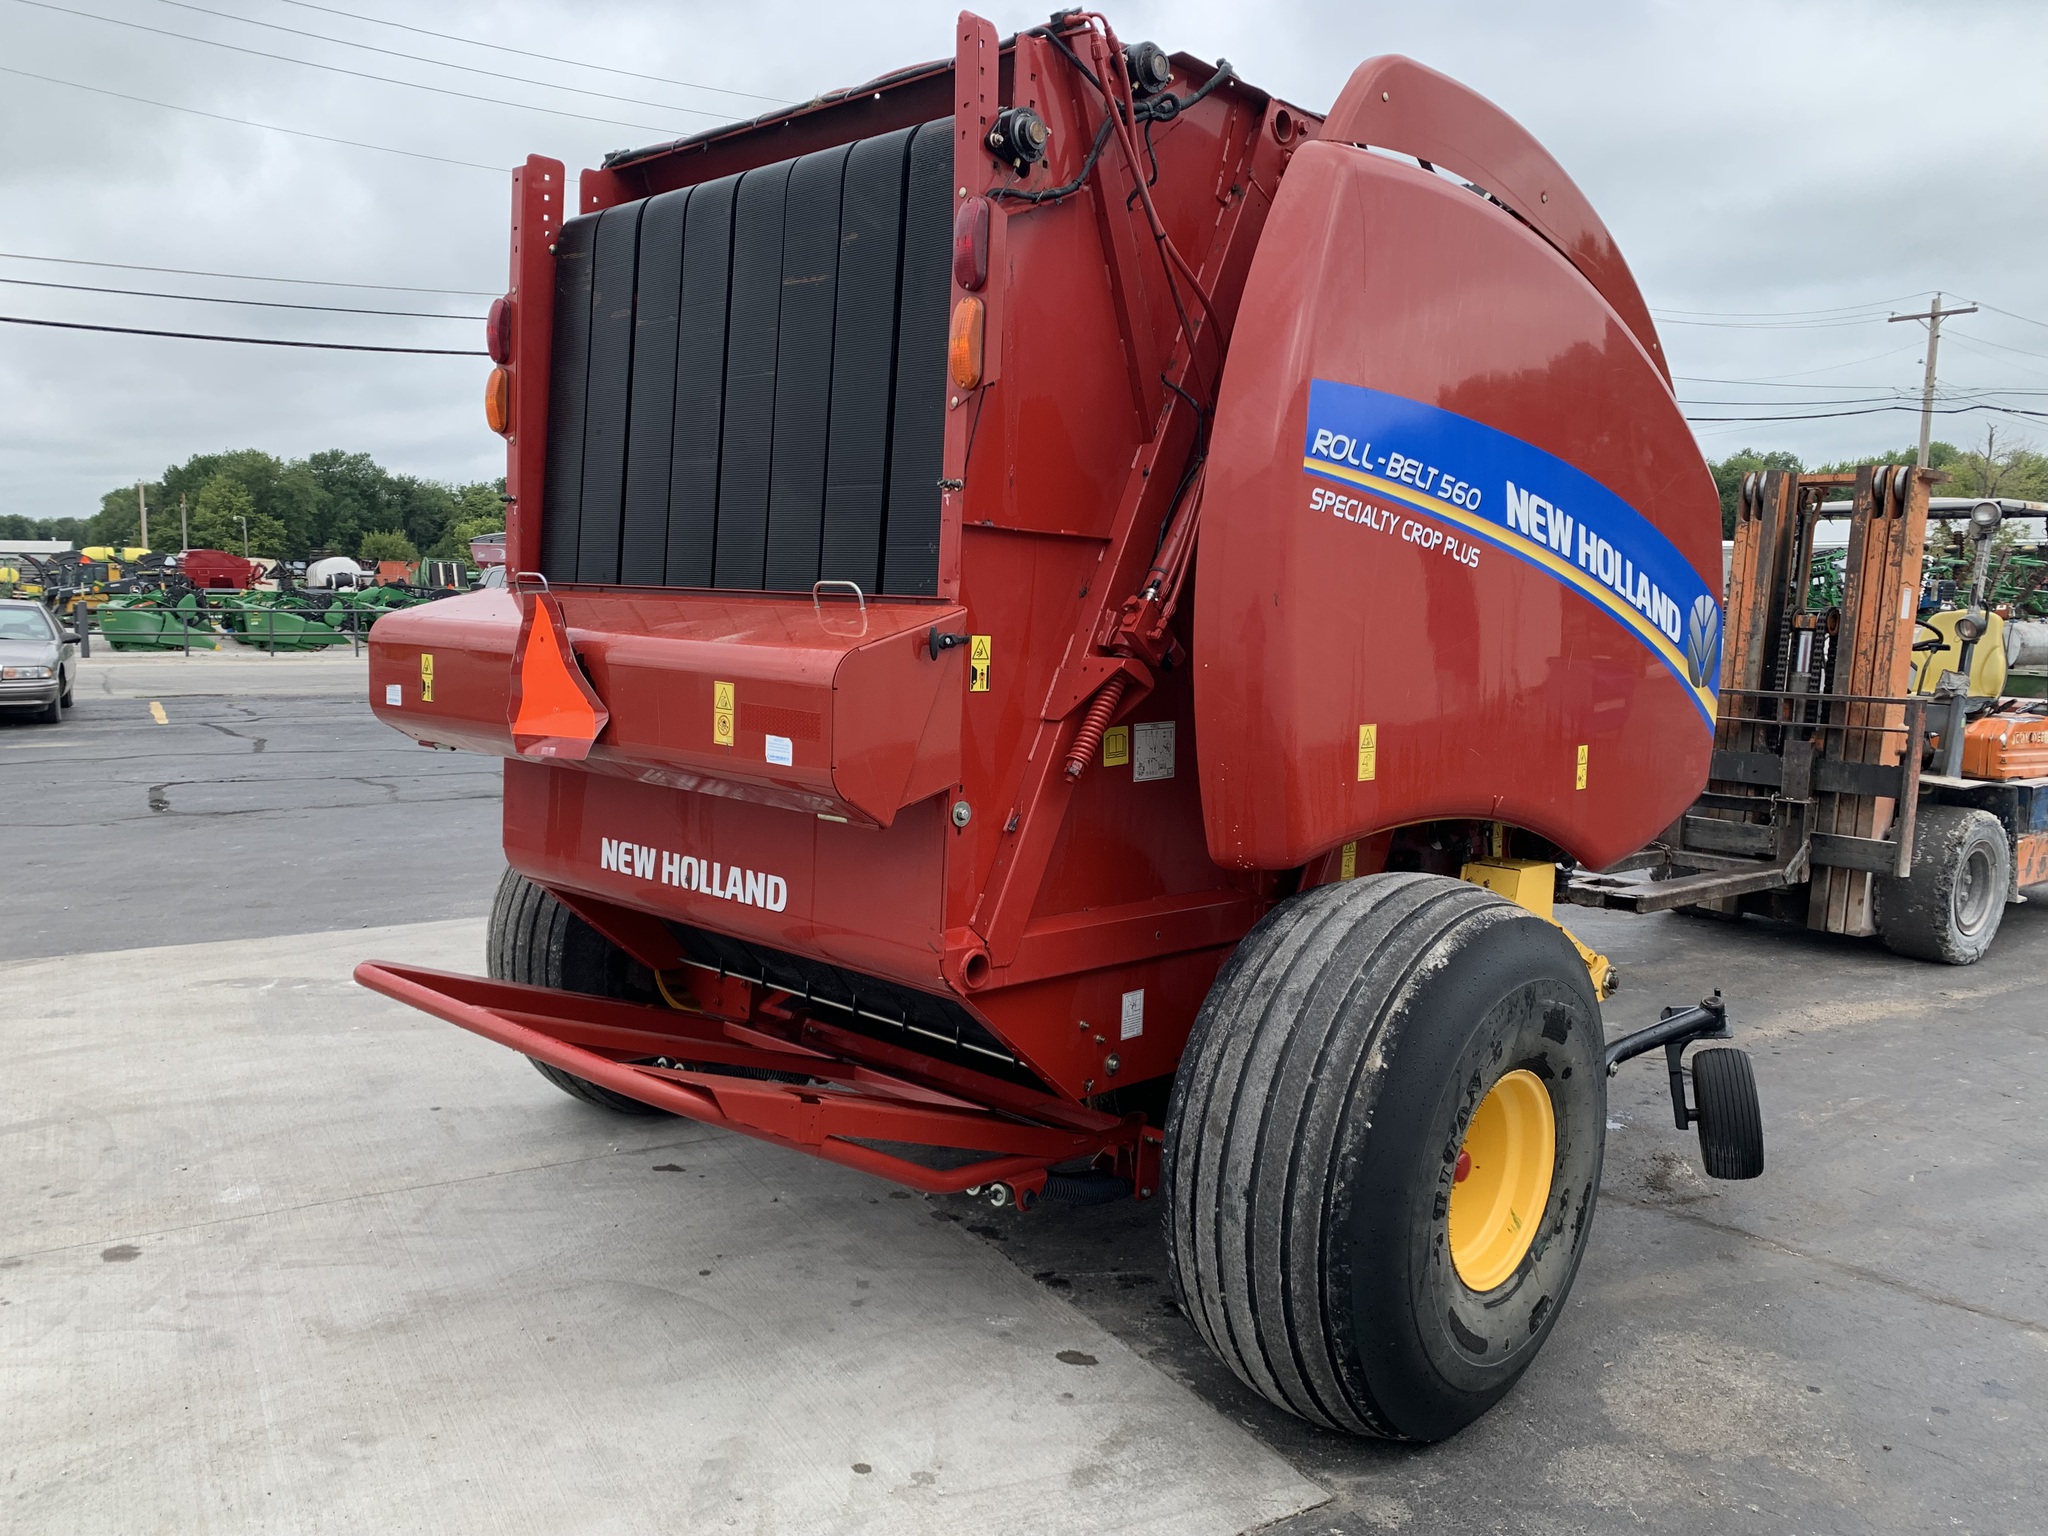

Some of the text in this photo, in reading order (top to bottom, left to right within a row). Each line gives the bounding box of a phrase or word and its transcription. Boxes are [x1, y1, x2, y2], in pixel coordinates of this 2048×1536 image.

[1309, 487, 1481, 568] SPECIALTY CROP PLUS
[1437, 473, 1482, 512] 560
[1505, 480, 1682, 644] NEW HOLLAND
[601, 837, 788, 913] NEW HOLLAND
